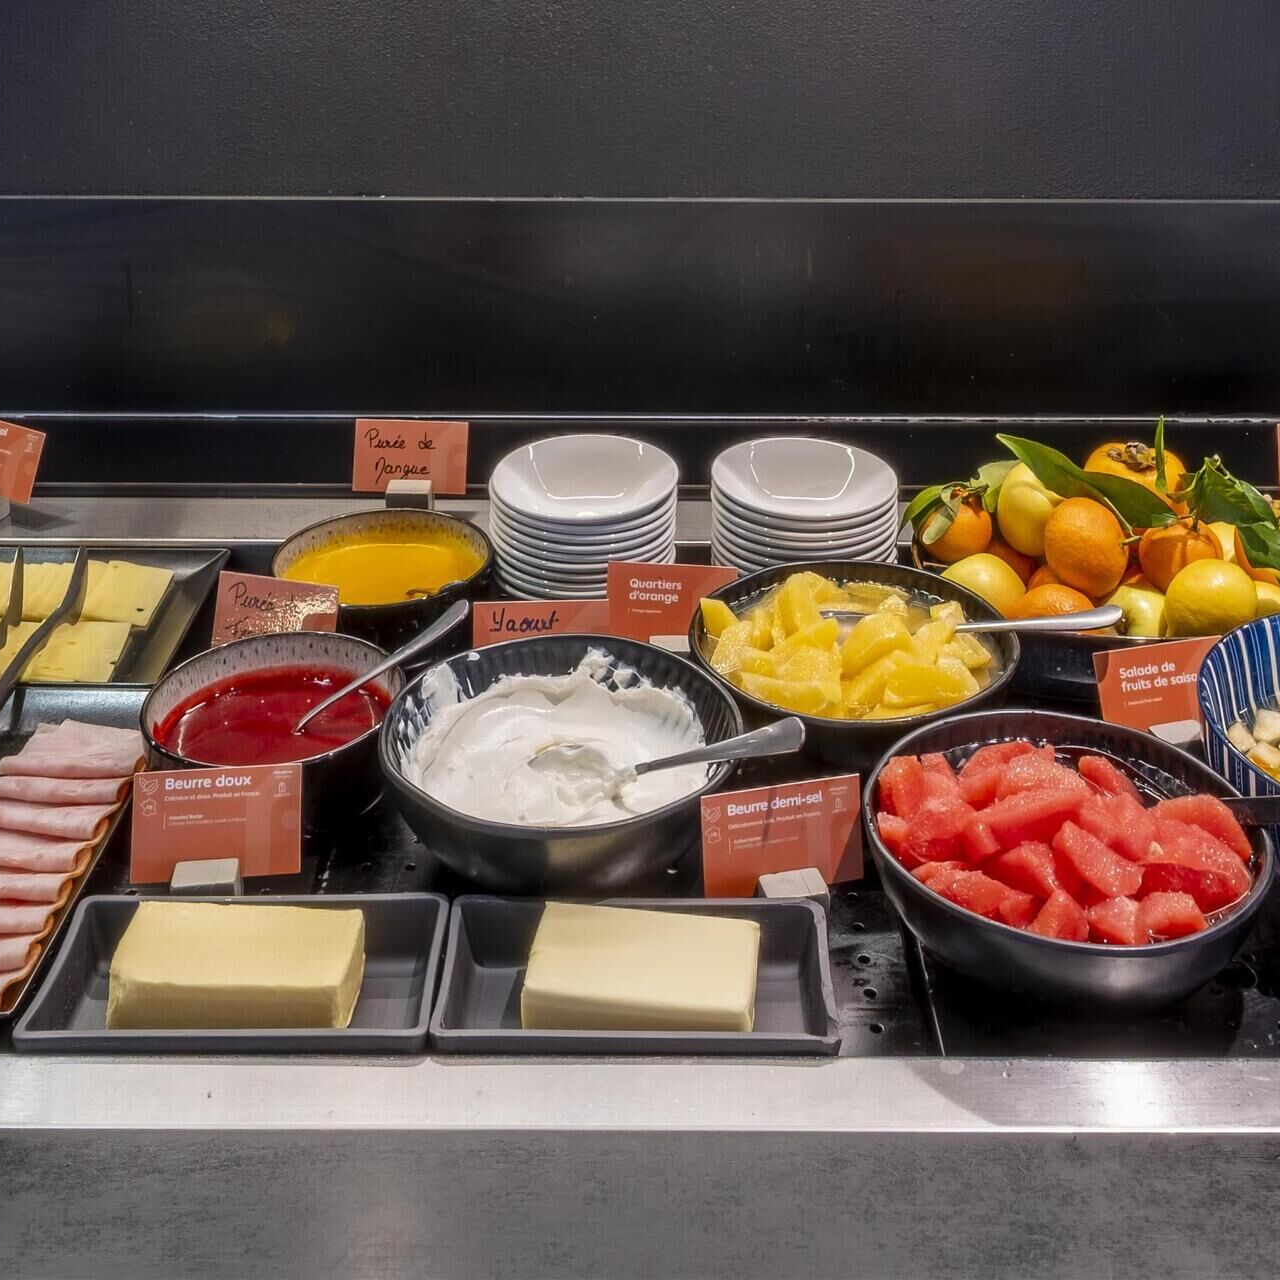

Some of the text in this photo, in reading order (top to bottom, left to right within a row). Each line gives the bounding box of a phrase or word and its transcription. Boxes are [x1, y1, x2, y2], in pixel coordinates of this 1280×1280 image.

[364, 427, 437, 450] Purée de
[629, 578, 682, 591] Quartiers
[629, 590, 679, 605] d'orange
[489, 608, 559, 633] Yaourt
[1119, 661, 1176, 679] Salade de
[1121, 672, 1198, 693] fruits de saiso
[164, 774, 252, 790] Beurre doux
[727, 802, 769, 816] Beurre
[770, 789, 823, 810] demi-sel
